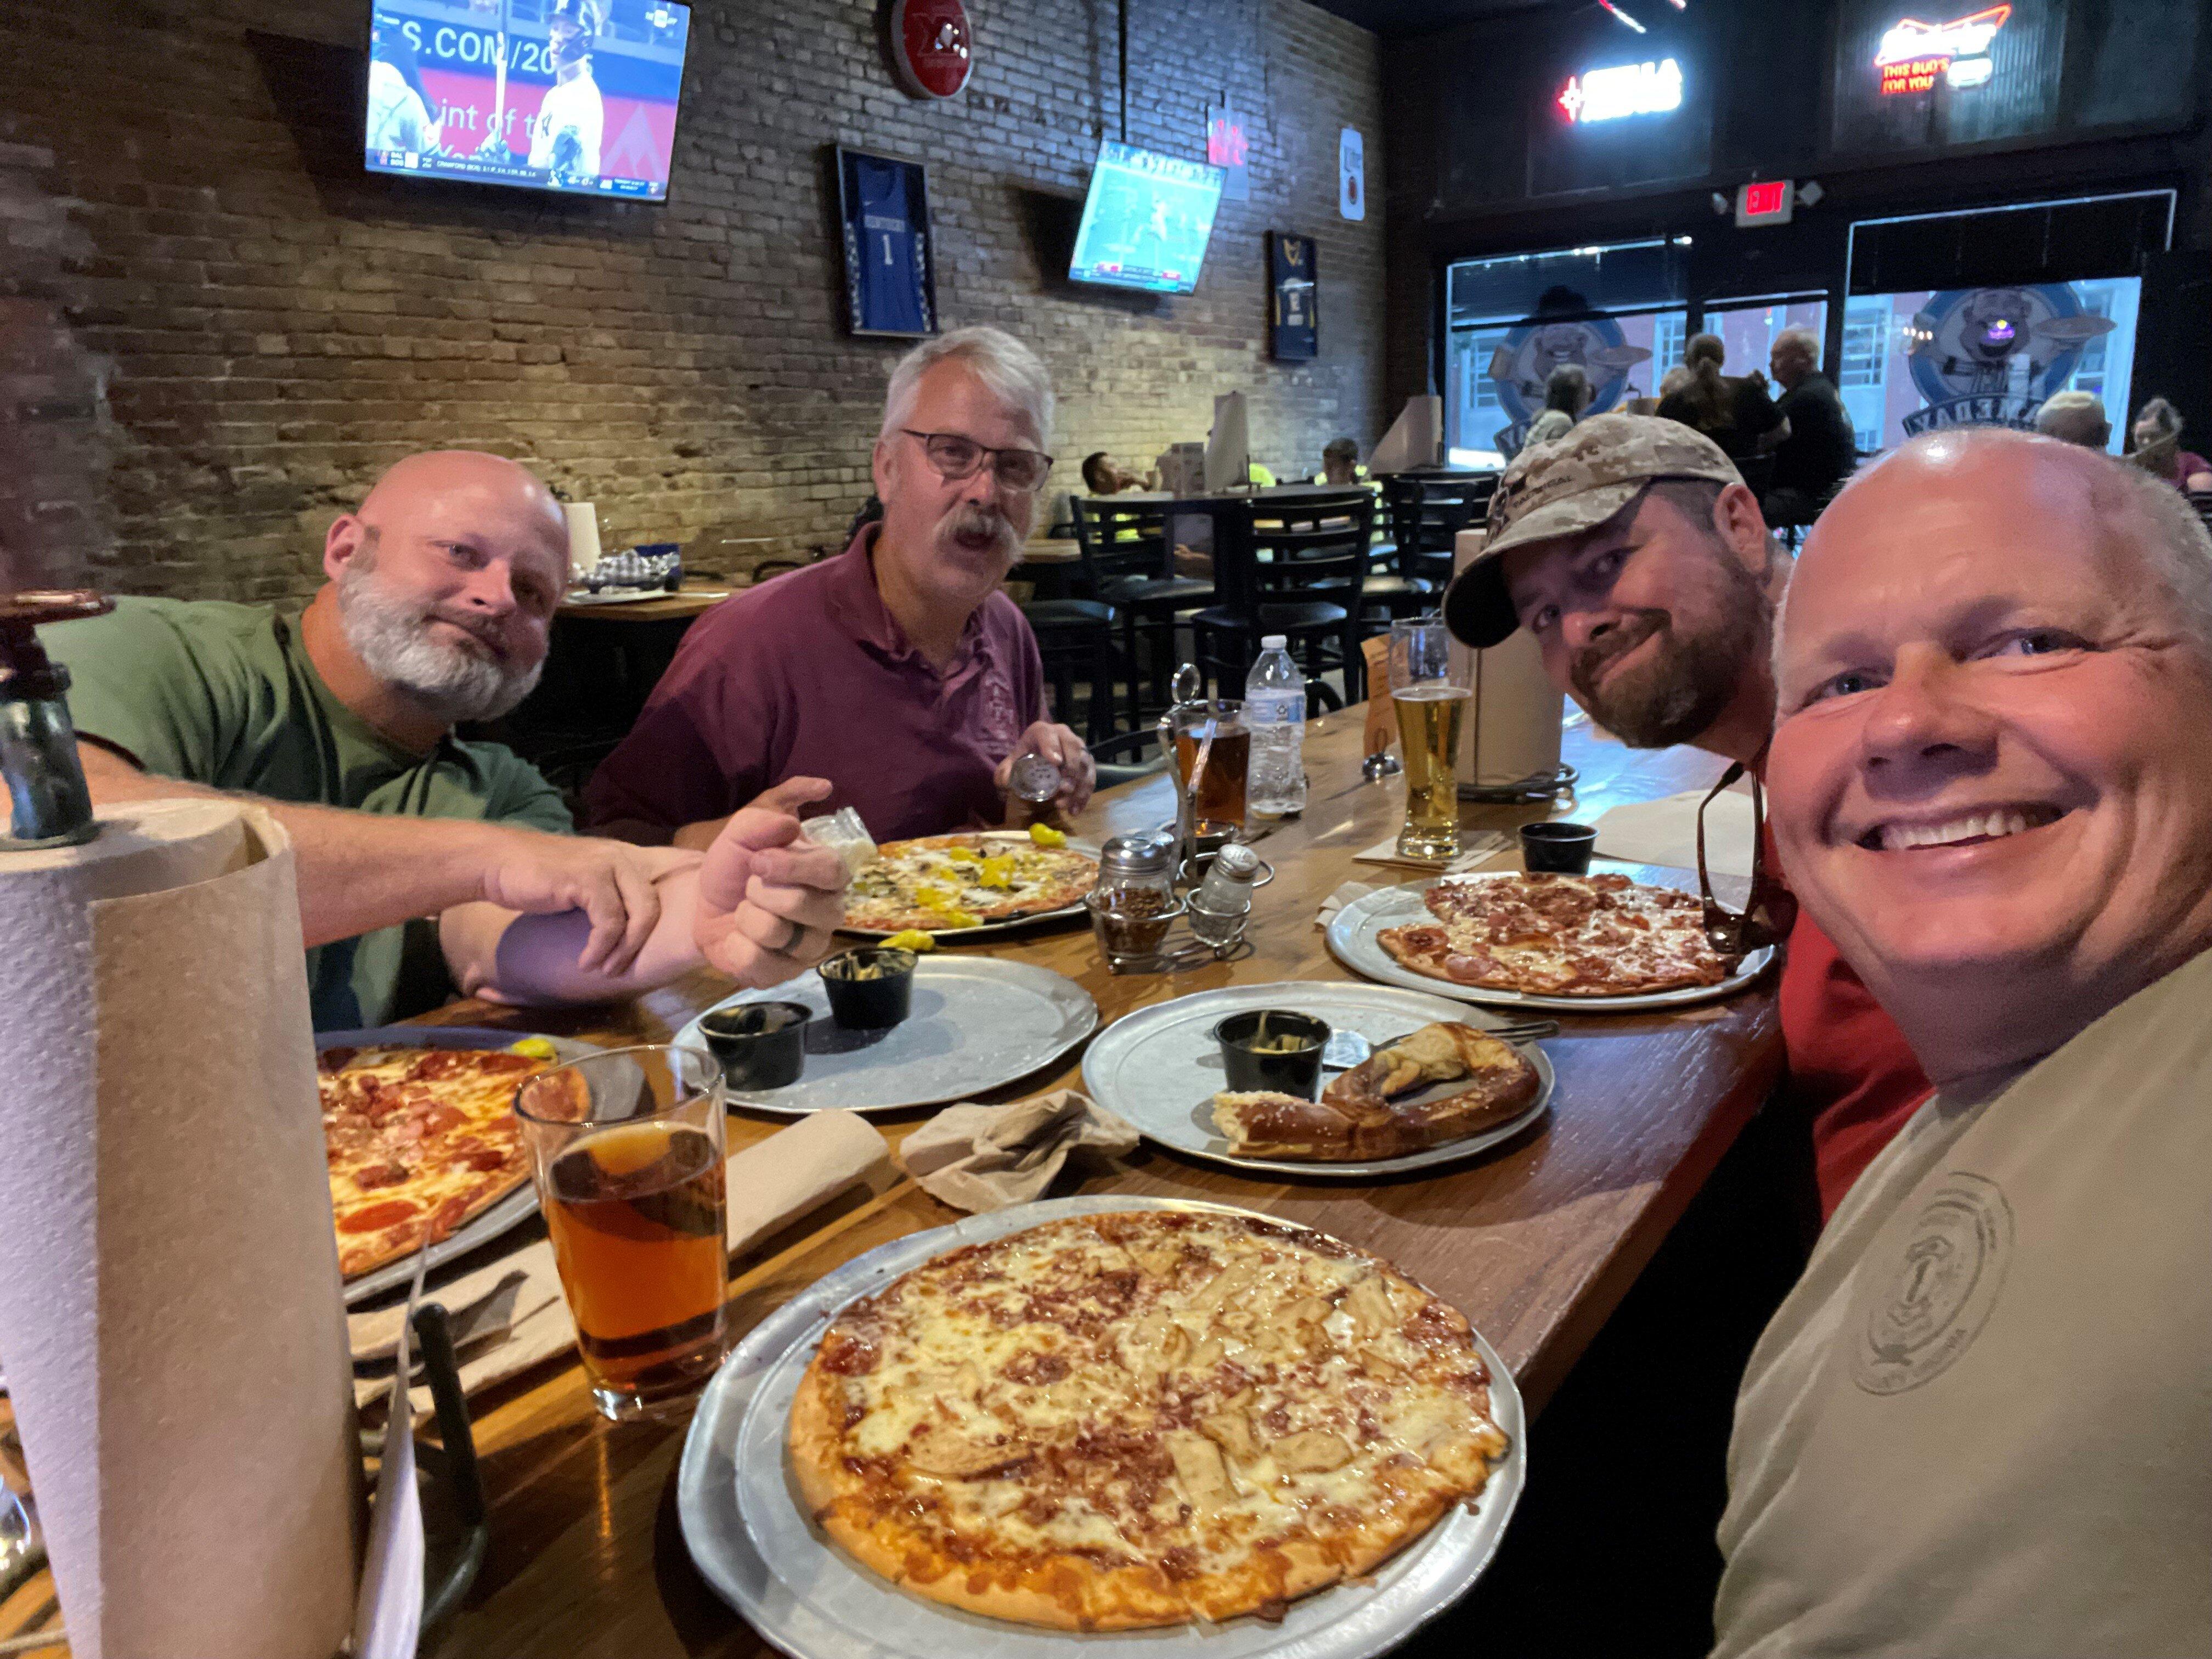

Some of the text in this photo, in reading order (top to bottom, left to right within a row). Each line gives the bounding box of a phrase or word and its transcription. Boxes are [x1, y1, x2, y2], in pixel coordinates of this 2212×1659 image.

[1883, 58, 1949, 78] THIS BUD'S
[1882, 79, 1906, 93] FOR
[1747, 182, 1785, 215] EXIT
[882, 234, 894, 265] 1
